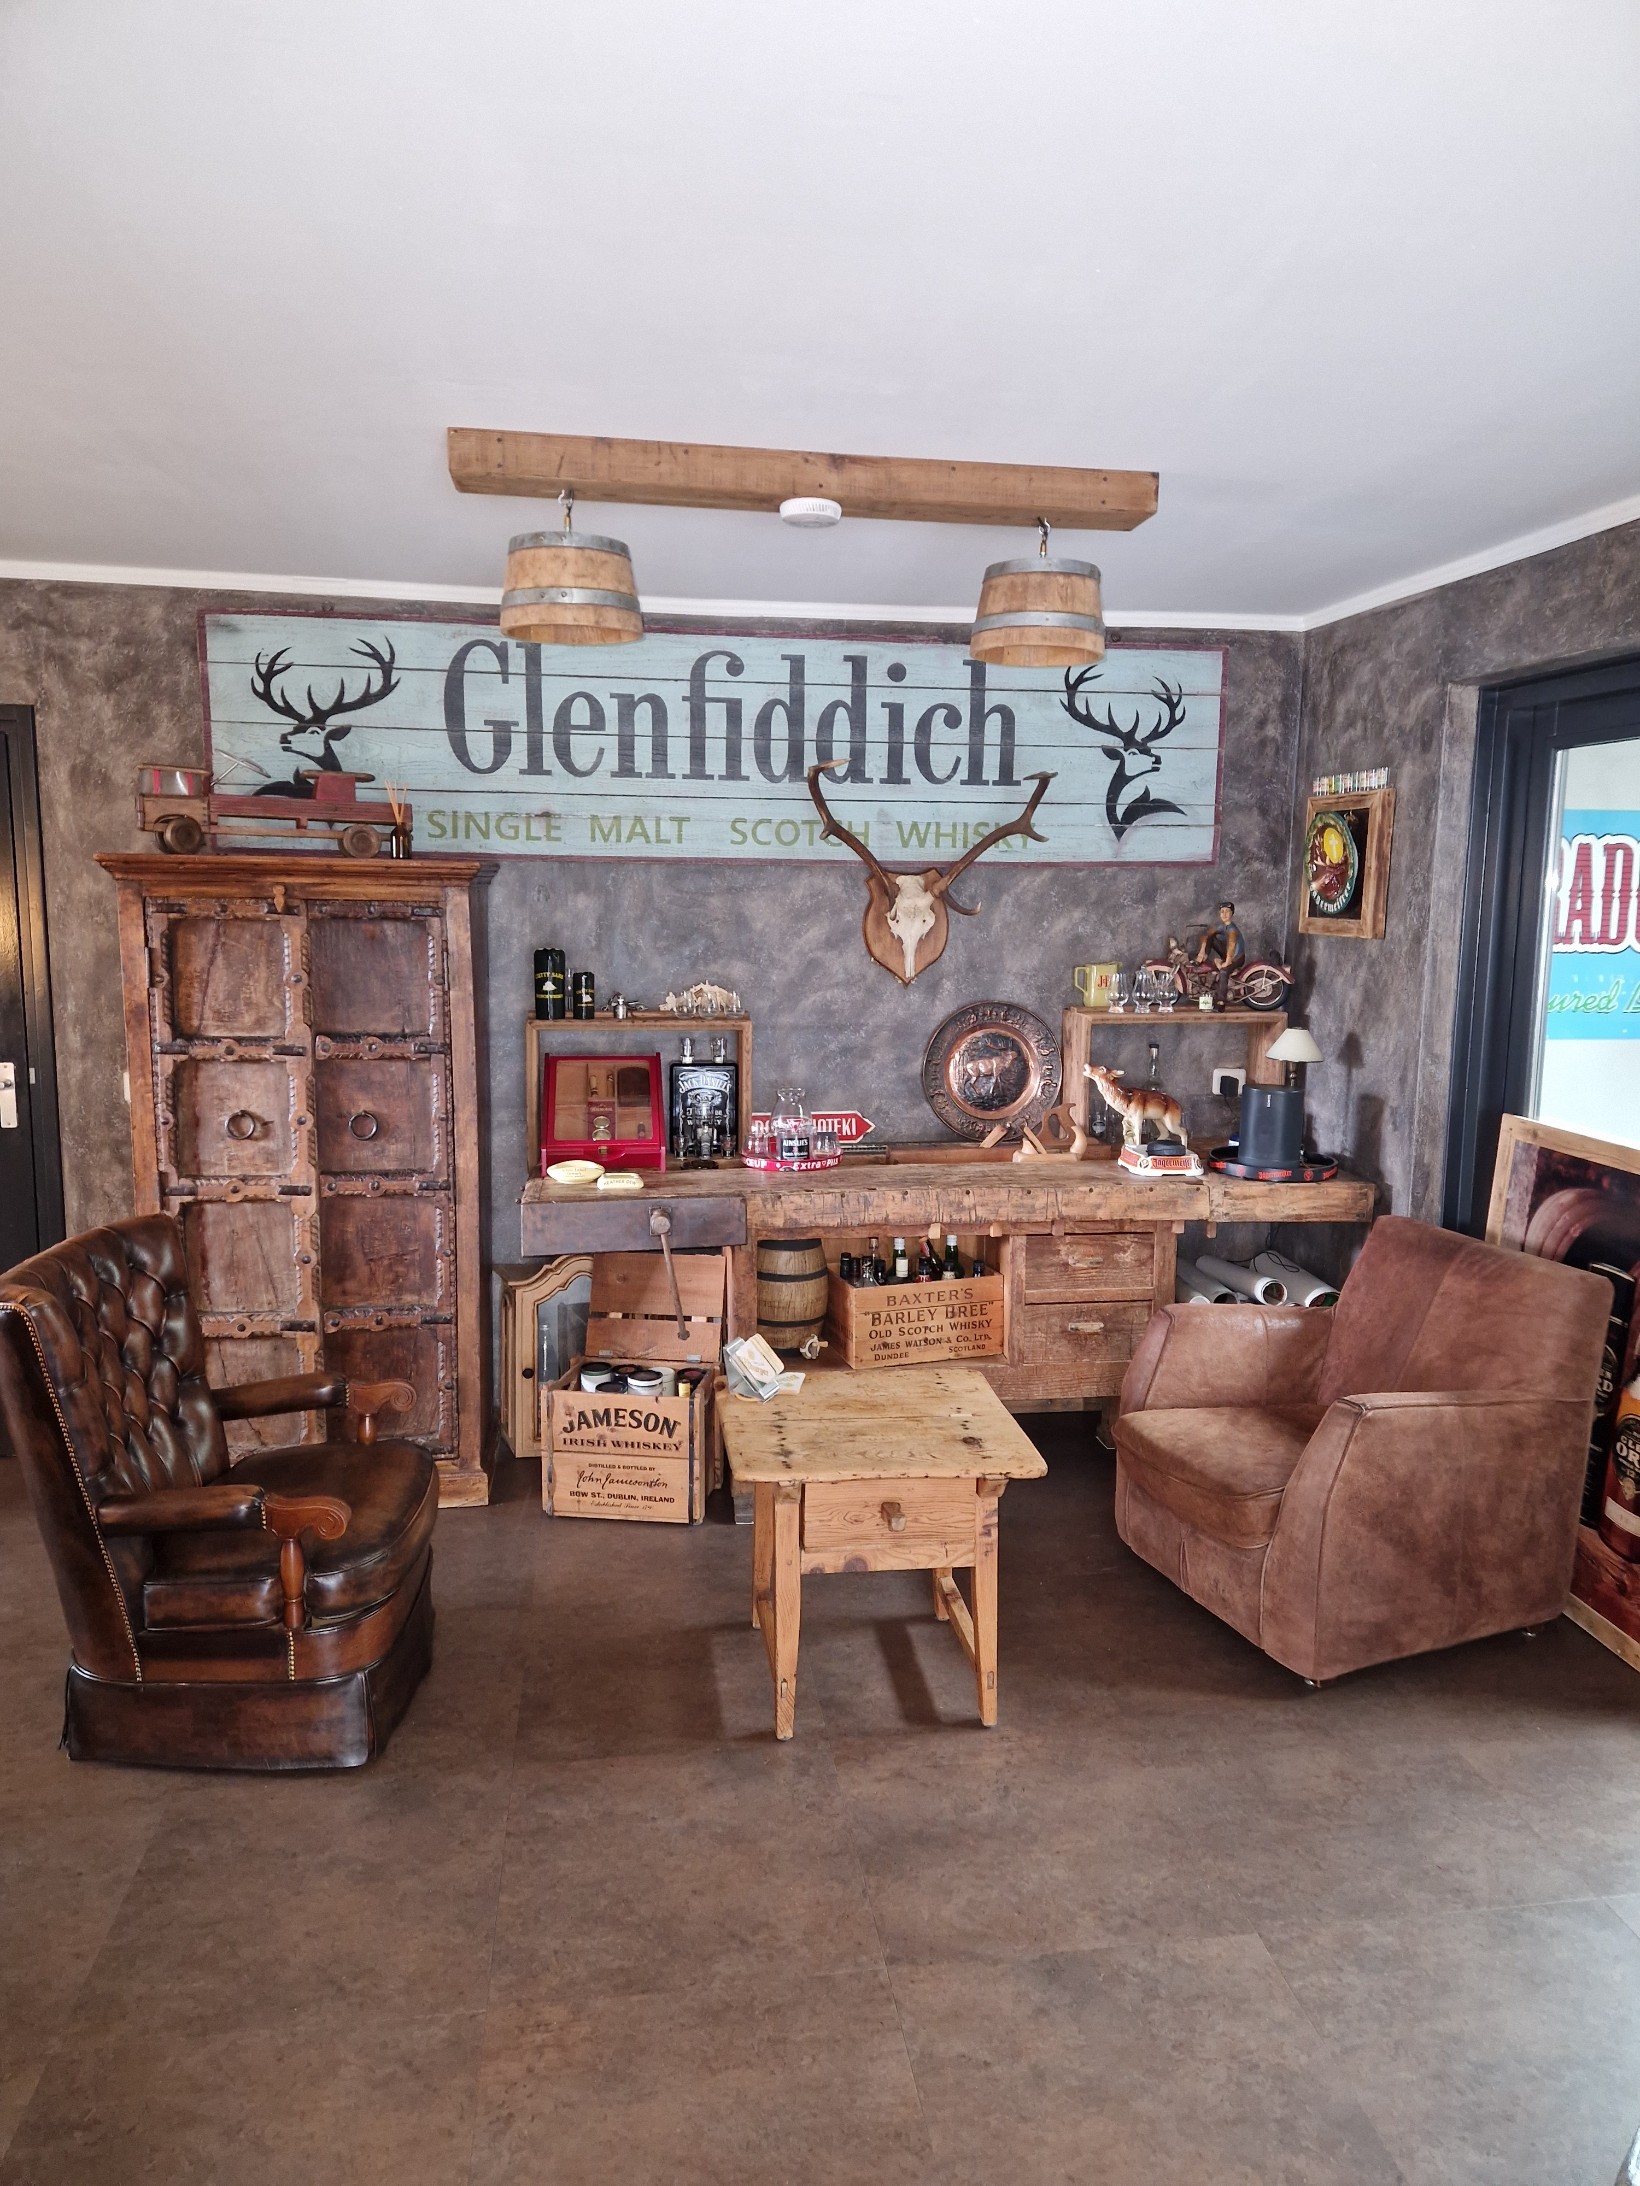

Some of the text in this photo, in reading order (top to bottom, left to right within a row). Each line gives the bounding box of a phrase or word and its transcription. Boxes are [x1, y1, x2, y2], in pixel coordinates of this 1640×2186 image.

[443, 638, 1022, 788] Glenfiddich
[427, 809, 562, 843] SINGLE
[589, 814, 691, 845] MALT
[678, 1077, 699, 1094] JACK
[793, 1158, 821, 1170] Extra
[886, 1288, 974, 1307] BAXTER'S
[949, 1318, 993, 1331] WHISKY
[870, 1341, 900, 1352] JAMES
[905, 1336, 943, 1349] WATSON
[562, 1407, 682, 1439] JAMESON
[562, 1437, 683, 1452] IRISH WHISKEY
[588, 1462, 616, 1470] DISTILLED
[569, 1489, 589, 1498] BOW
[641, 1495, 675, 1504] IRELAND
